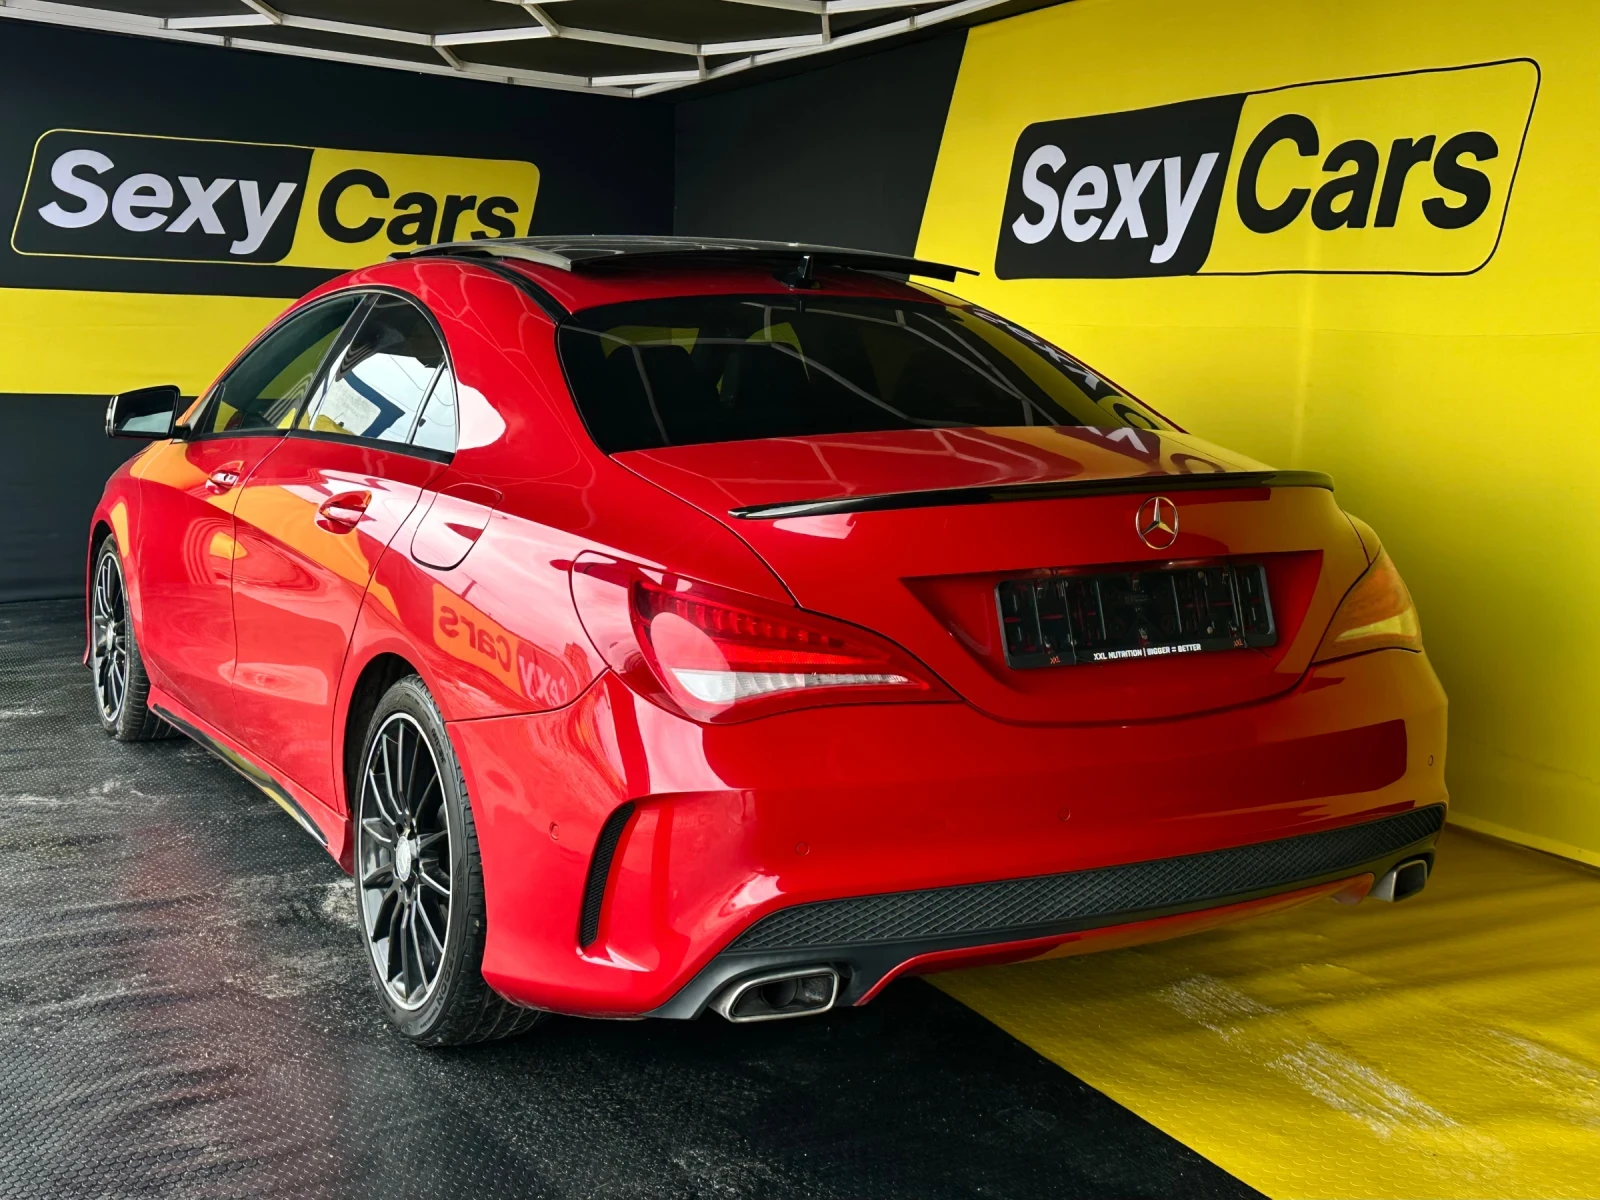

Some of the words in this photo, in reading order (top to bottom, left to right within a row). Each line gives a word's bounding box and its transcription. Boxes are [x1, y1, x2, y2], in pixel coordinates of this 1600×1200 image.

[38, 149, 297, 255] Sexy
[318, 168, 519, 246] Cars
[1012, 145, 1219, 263] Sexy
[1237, 114, 1499, 233] Cars
[1093, 652, 1107, 660] XXL
[1108, 649, 1142, 659] NUTRITION
[1146, 646, 1170, 656] BIGGER
[1177, 643, 1201, 653] BETTER
